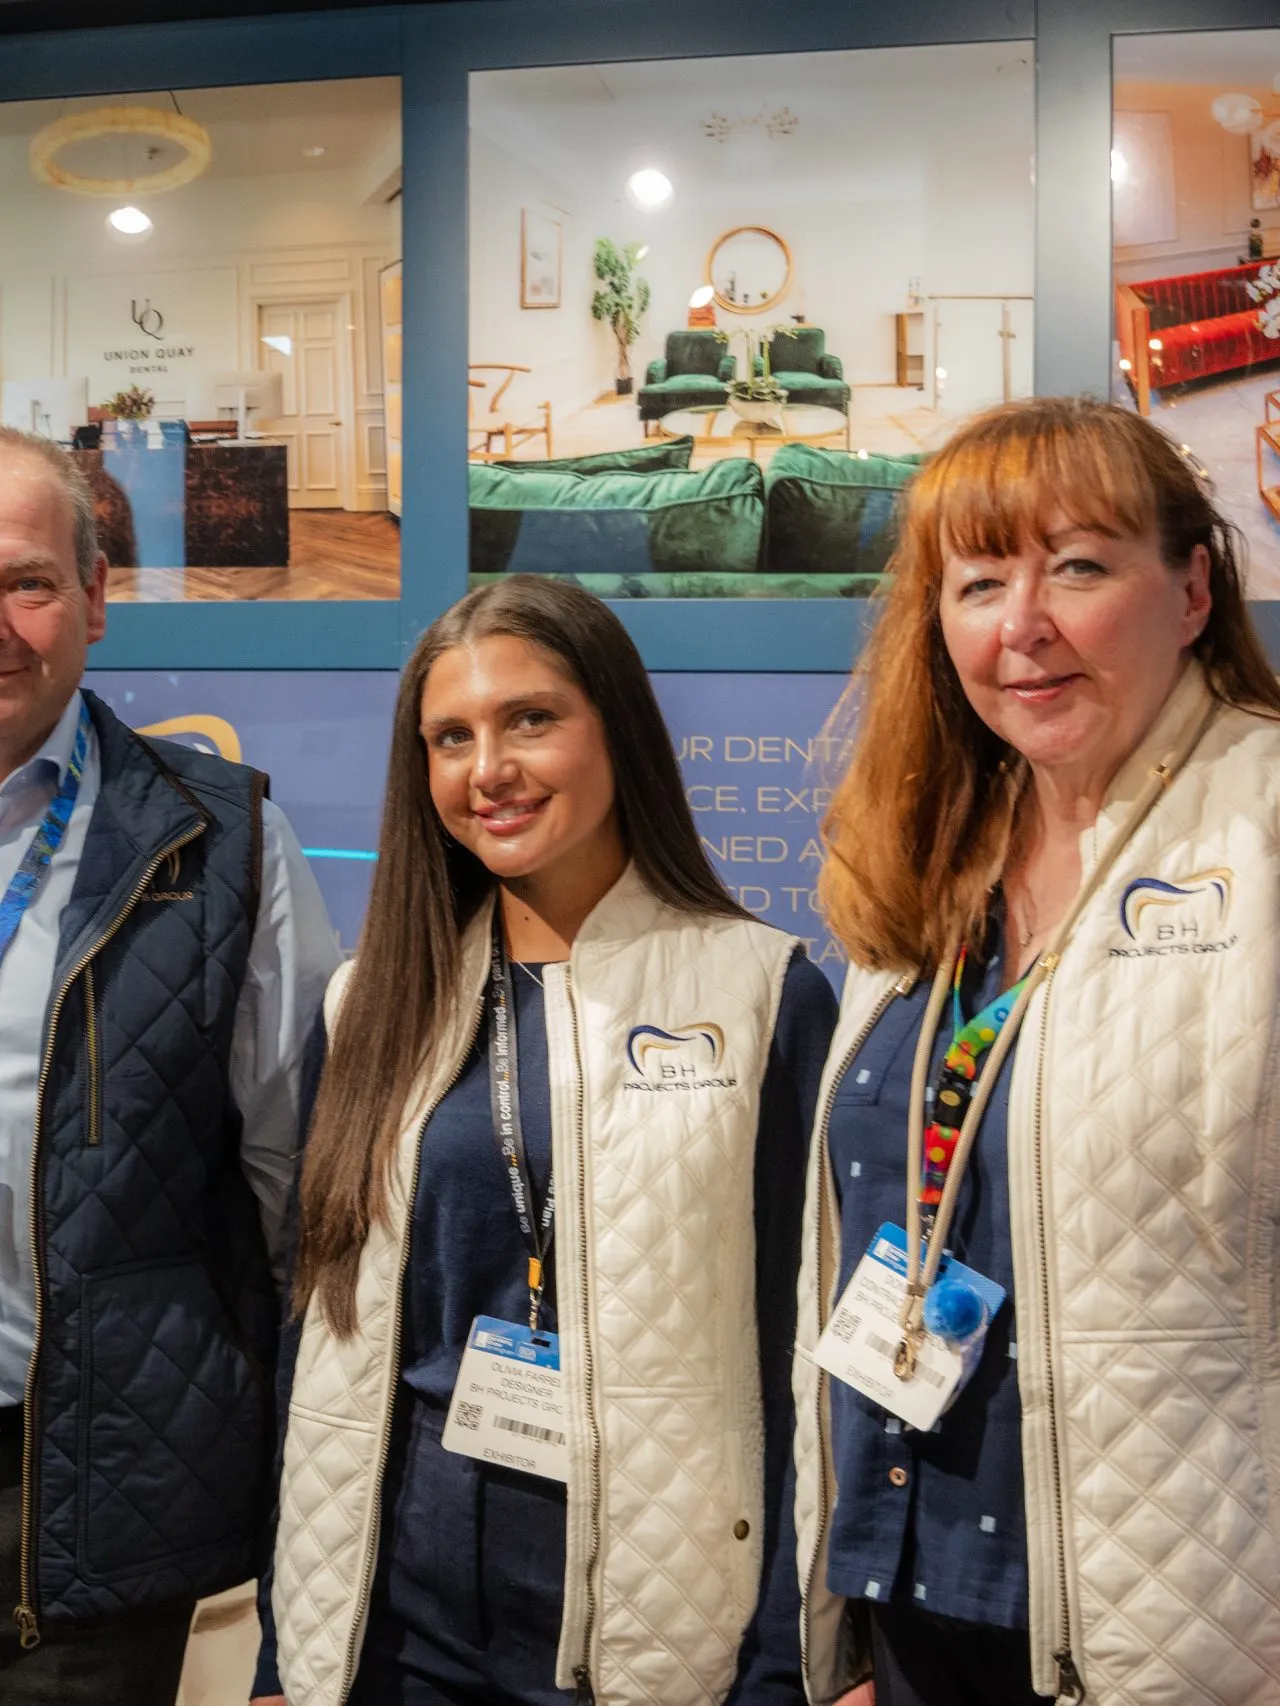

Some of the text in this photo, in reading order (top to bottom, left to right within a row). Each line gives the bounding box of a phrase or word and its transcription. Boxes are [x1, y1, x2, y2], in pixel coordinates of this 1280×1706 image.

[103, 345, 195, 361] UNION QUAY
[129, 365, 168, 374] DENTAL
[724, 736, 854, 763] DENTA
[1108, 934, 1238, 959] PROJECTS GROUP
[624, 1079, 737, 1092] PROJECTS GROUP
[490, 1362, 561, 1388] OLIVIA FARREL
[470, 1382, 484, 1394] BH
[486, 1387, 538, 1409] PROJECTS
[500, 1377, 553, 1398] DESIGNER
[482, 1447, 537, 1469] EXHIBITOR
